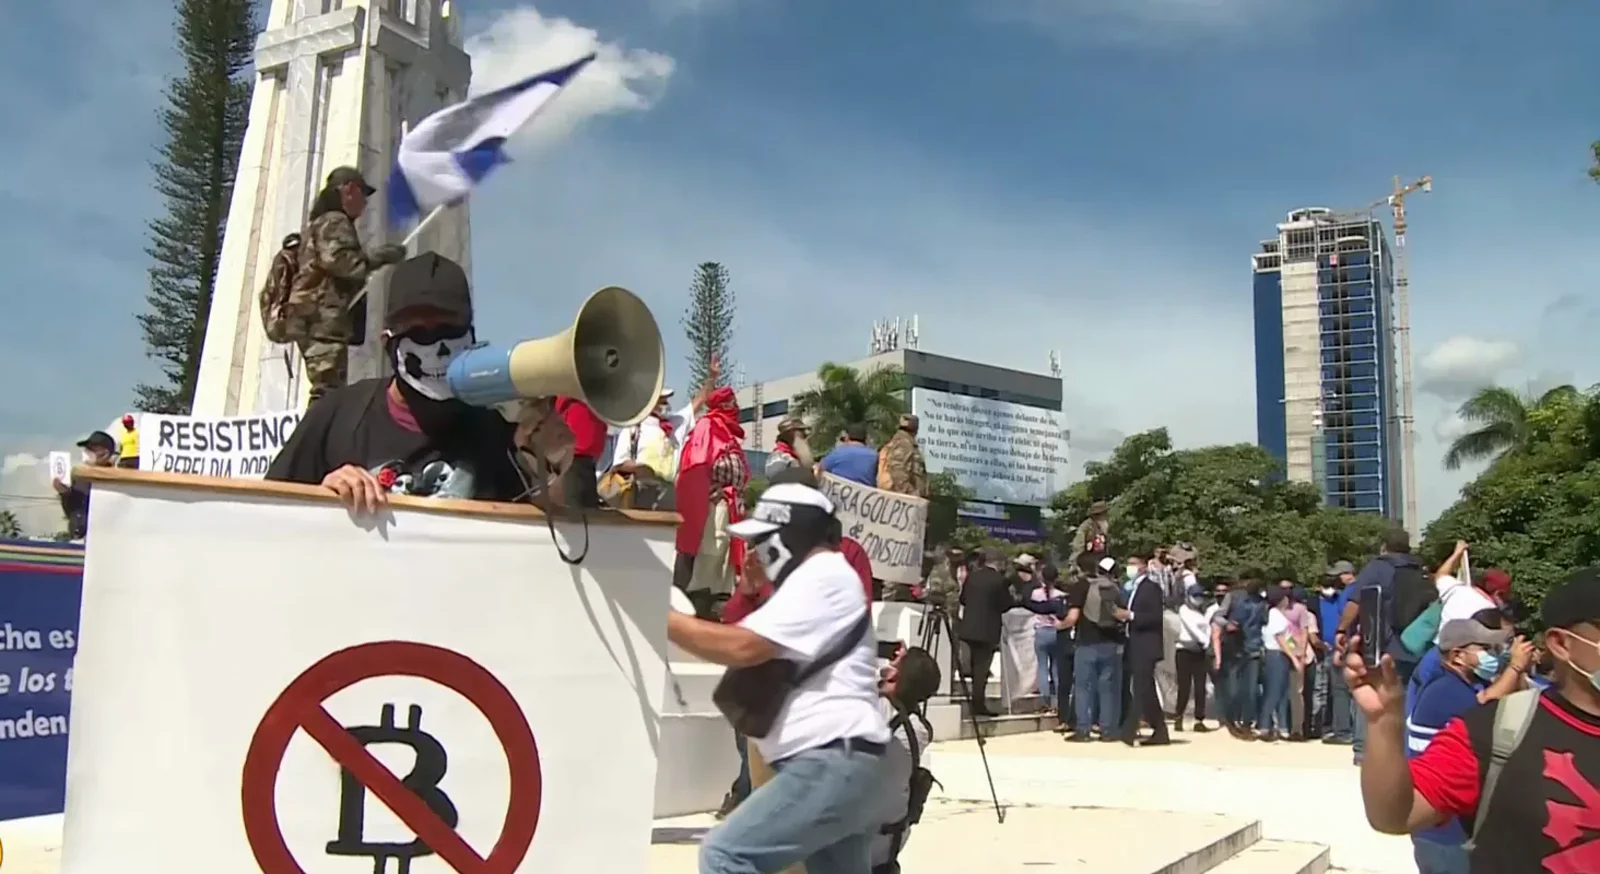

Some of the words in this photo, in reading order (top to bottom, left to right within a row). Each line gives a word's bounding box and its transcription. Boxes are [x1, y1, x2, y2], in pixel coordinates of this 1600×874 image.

[924, 410, 934, 419] No
[928, 424, 936, 433] de
[938, 425, 945, 434] lo
[946, 428, 959, 438] que
[928, 436, 935, 445] la
[929, 450, 939, 459] No
[48, 629, 75, 650] es
[18, 666, 57, 693] los
